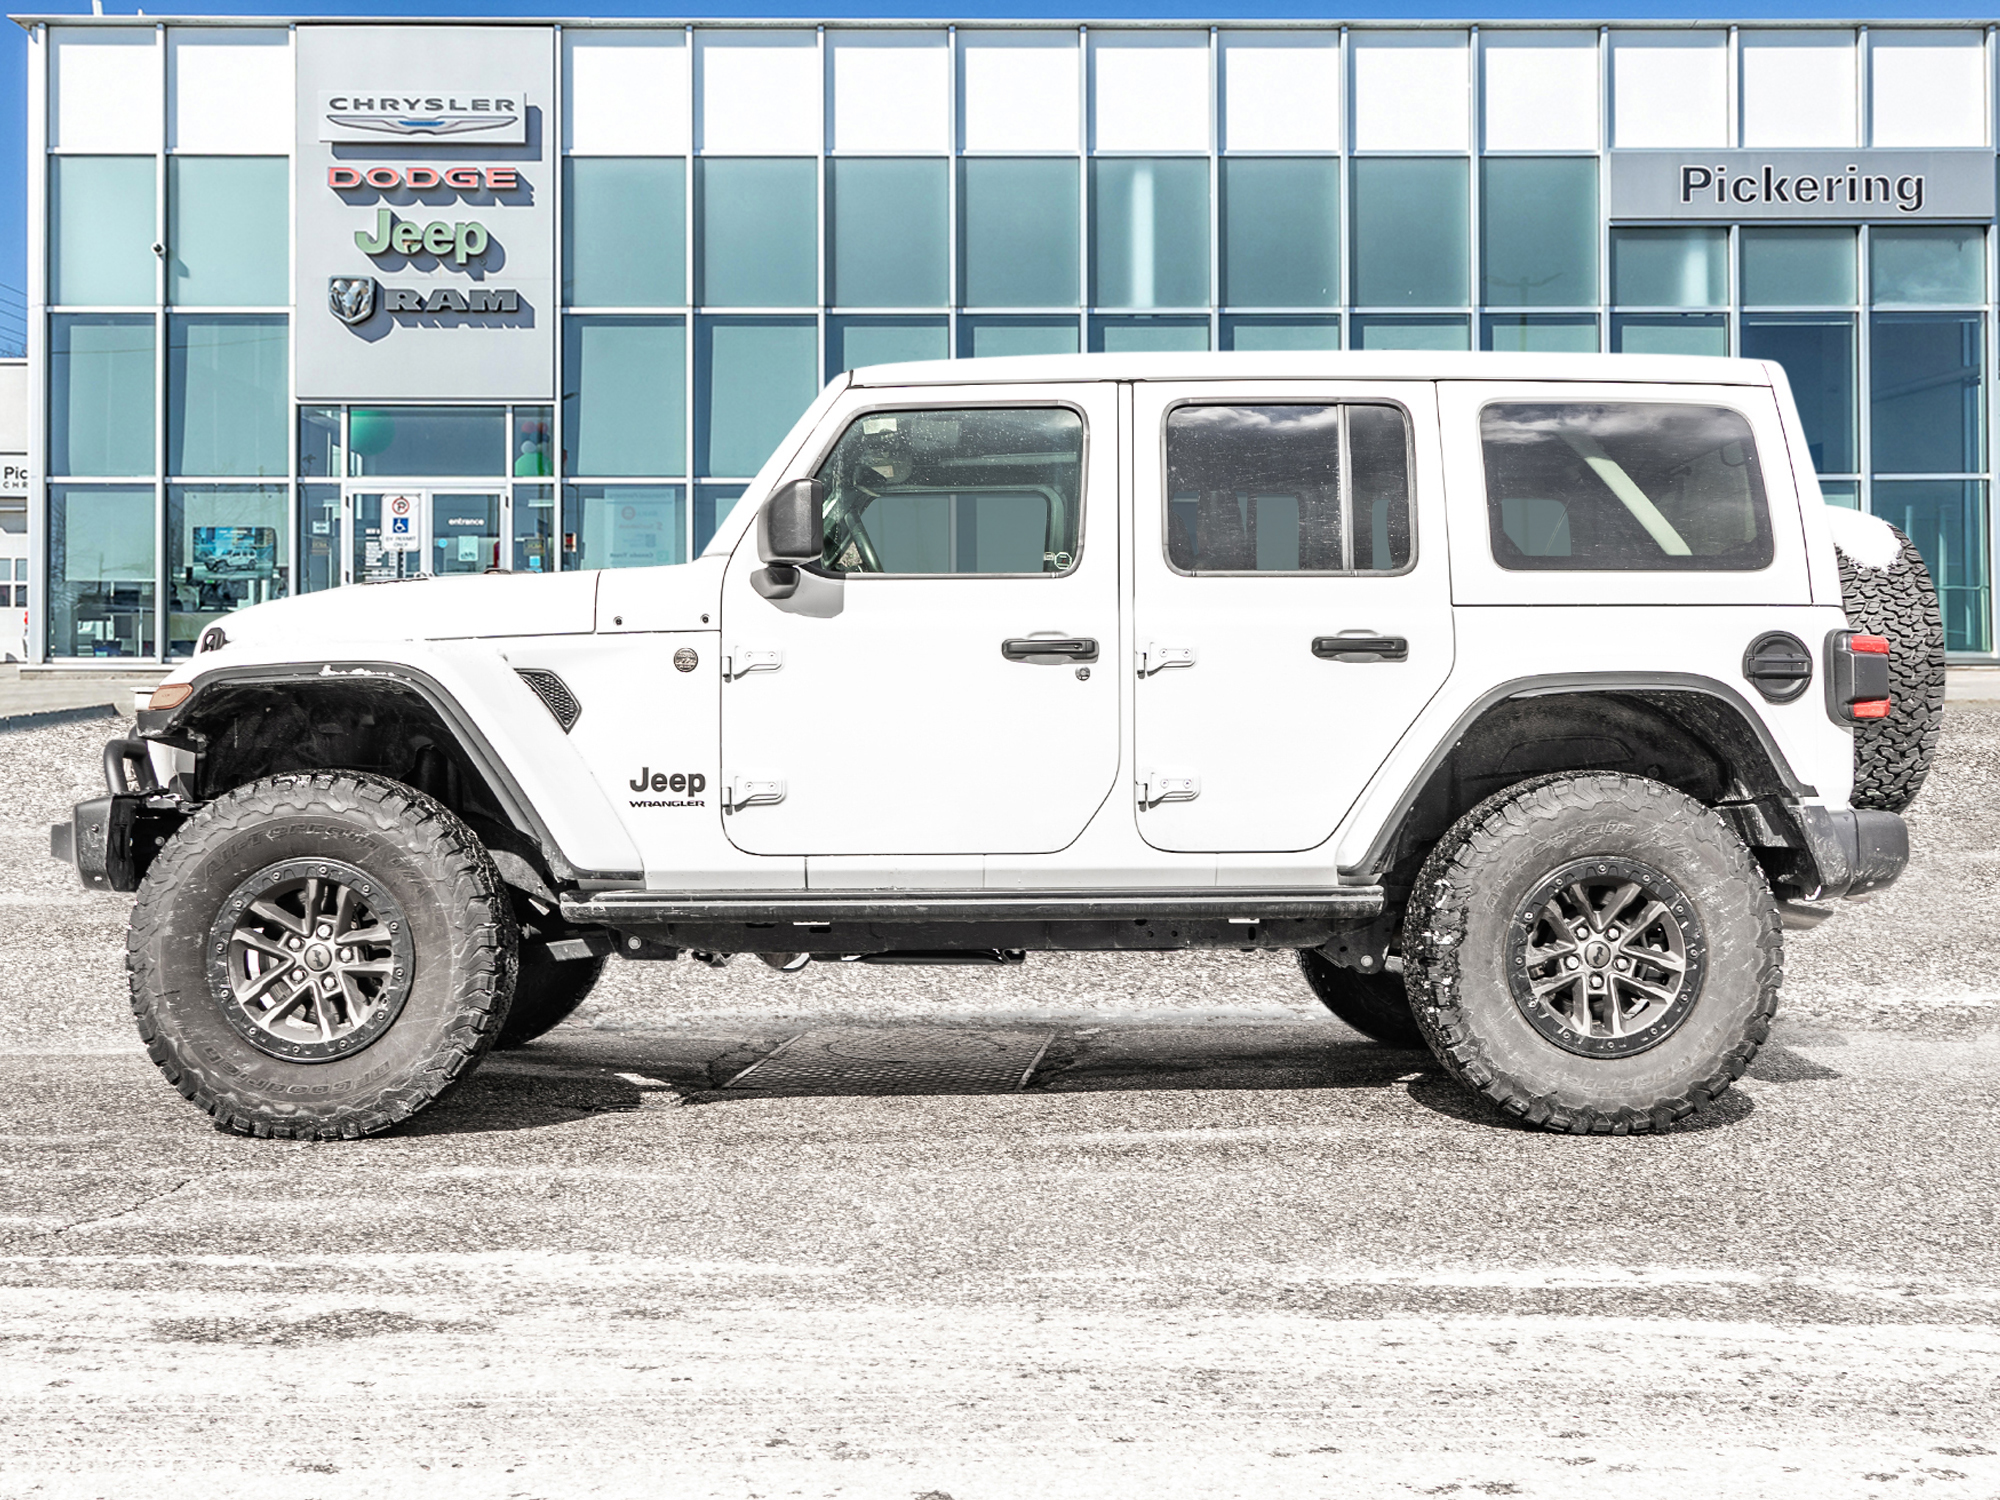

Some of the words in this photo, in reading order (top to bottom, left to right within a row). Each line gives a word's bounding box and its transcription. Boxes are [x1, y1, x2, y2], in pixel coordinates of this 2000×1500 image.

[329, 97, 515, 111] CHRYSLER
[327, 166, 518, 189] DODGE
[1680, 165, 1925, 213] Pickering
[354, 208, 489, 264] Jeep
[383, 288, 520, 312] RAM
[4, 466, 28, 480] Pic
[448, 517, 485, 526] entrance
[629, 766, 706, 798] Jeep
[629, 800, 706, 808] WRANGLER
